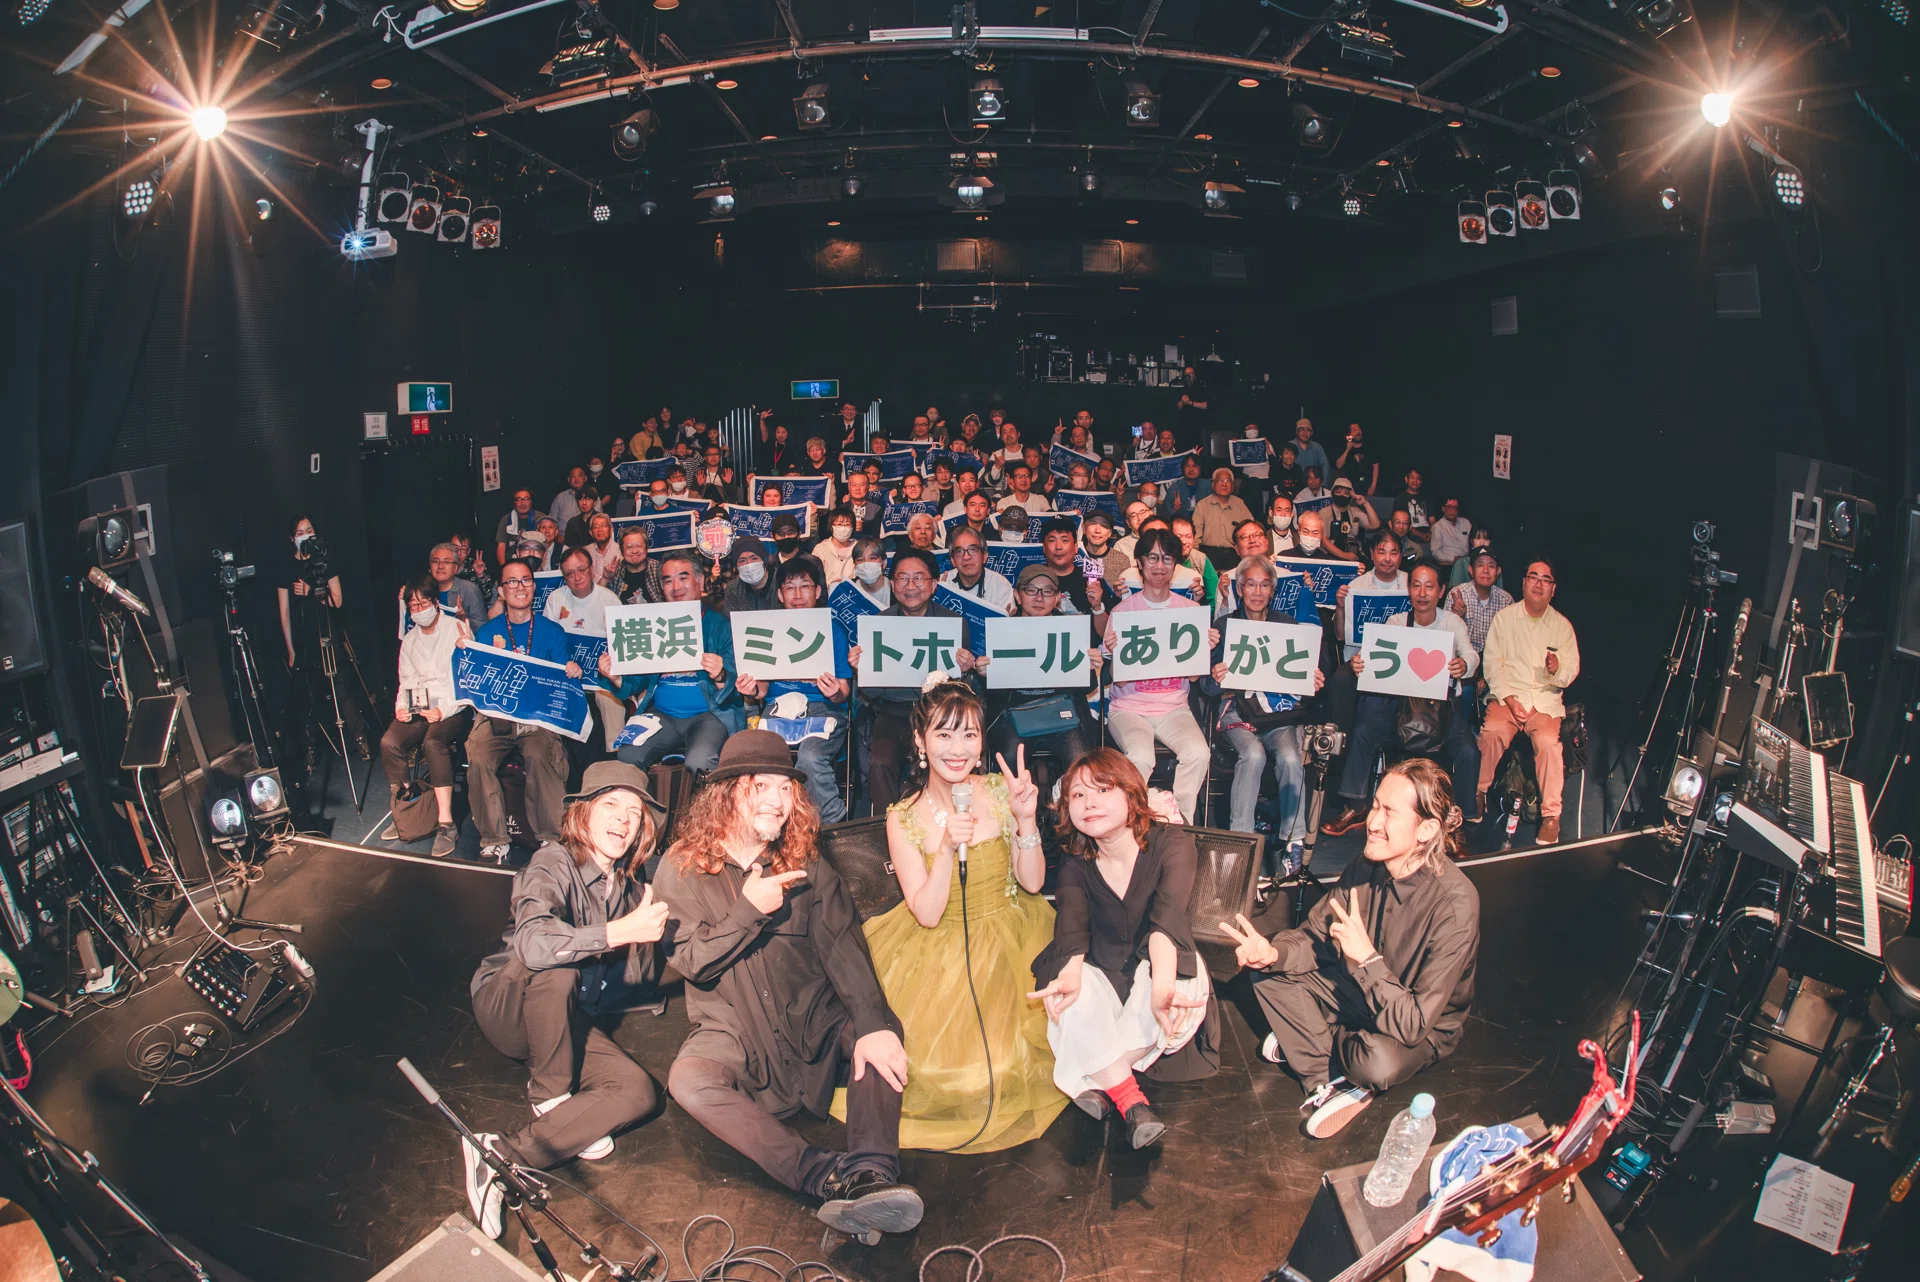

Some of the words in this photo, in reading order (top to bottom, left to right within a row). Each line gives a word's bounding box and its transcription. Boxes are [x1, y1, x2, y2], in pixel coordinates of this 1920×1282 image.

[611, 615, 698, 663] 横浜
[743, 627, 825, 664] ミン
[872, 631, 956, 673] トホ
[992, 631, 1086, 674] ール
[1118, 623, 1201, 665] あり
[1228, 634, 1310, 680] がと
[1369, 638, 1402, 680] う
